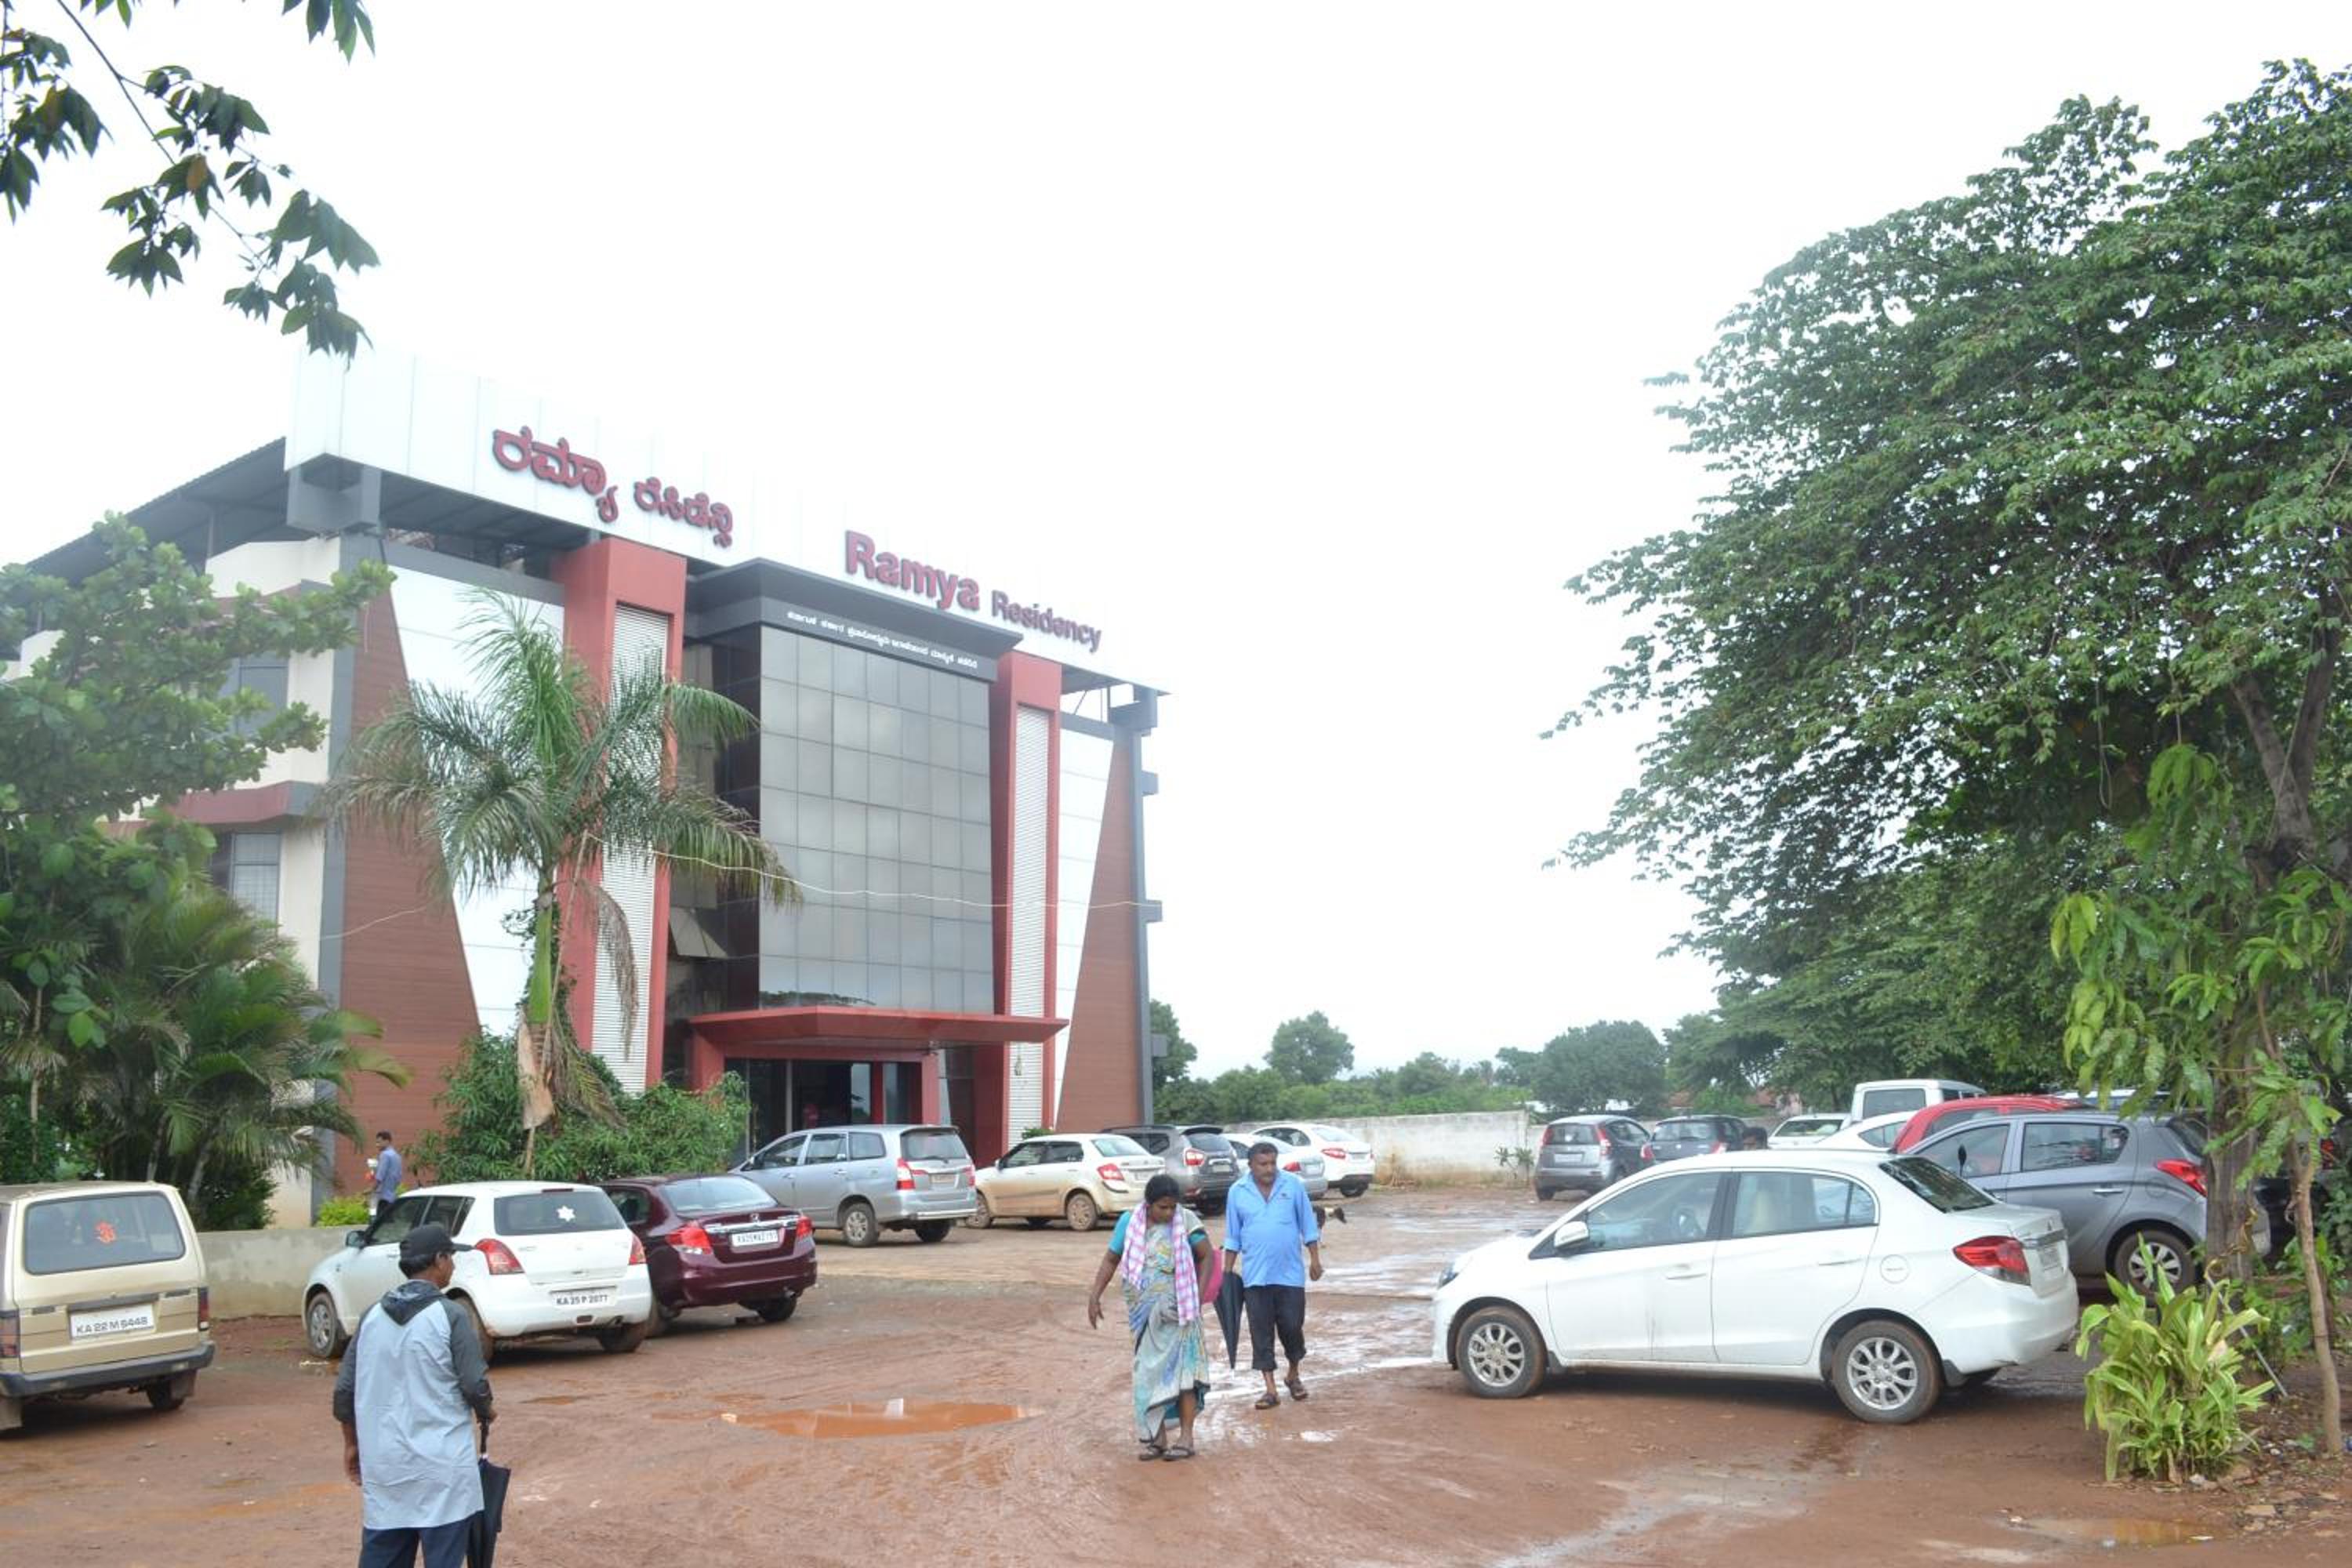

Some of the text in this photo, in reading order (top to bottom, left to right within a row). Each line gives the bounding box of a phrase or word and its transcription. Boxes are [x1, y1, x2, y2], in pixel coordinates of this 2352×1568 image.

[492, 425, 619, 523] ರಮ್ಯಾ
[844, 530, 981, 611] Ramya
[991, 590, 1102, 653] Residency
[76, 1323, 93, 1334] KA
[109, 1319, 121, 1330] M
